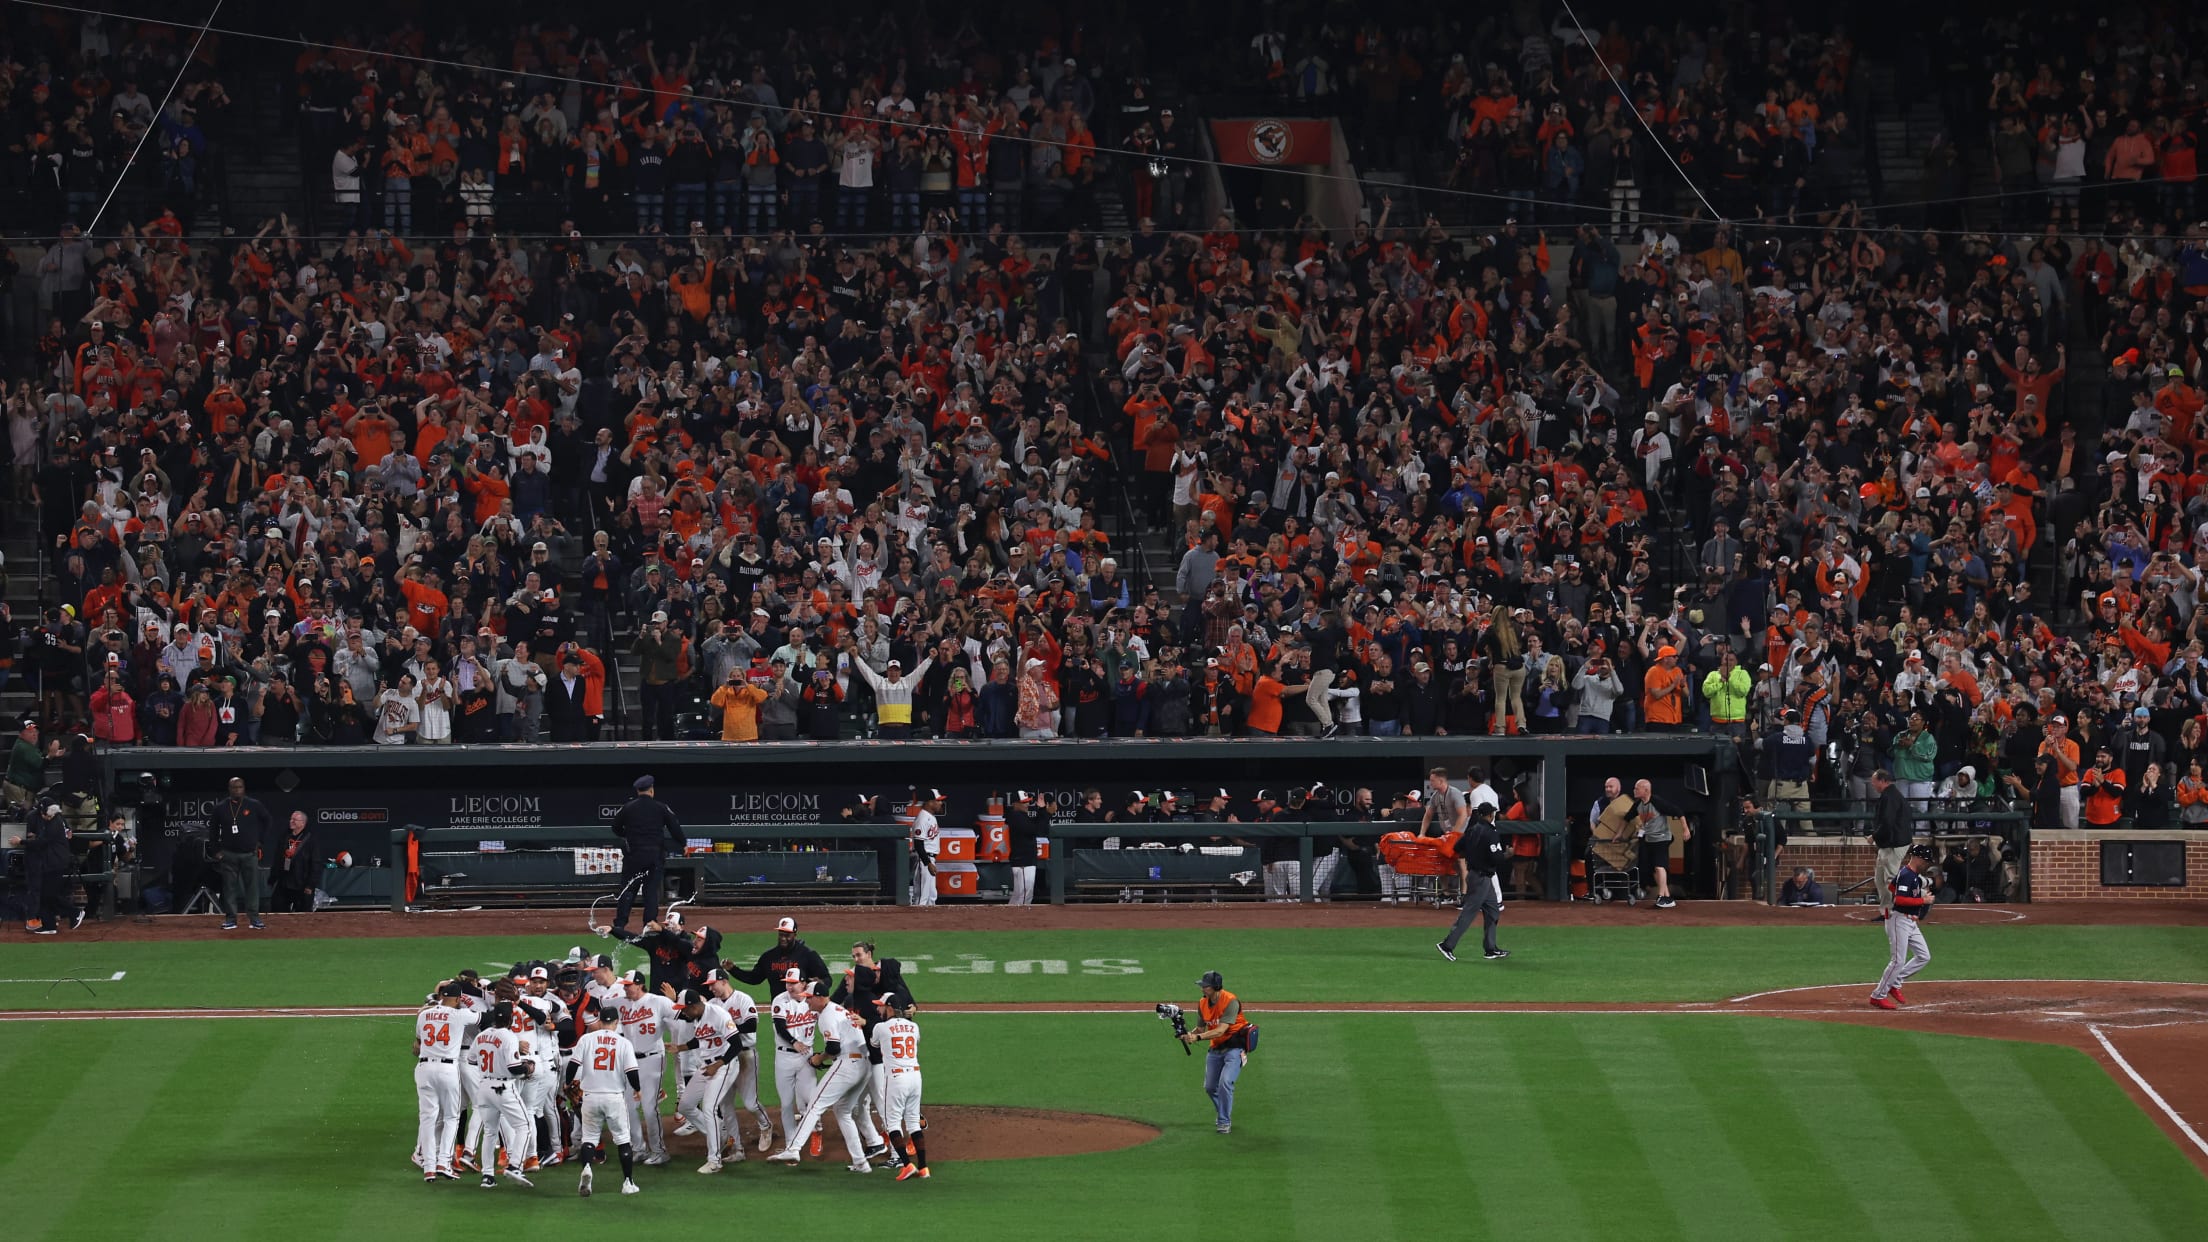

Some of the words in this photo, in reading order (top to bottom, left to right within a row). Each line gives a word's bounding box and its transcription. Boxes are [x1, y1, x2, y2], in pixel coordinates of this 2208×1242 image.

[450, 816, 471, 824] LAKE
[472, 816, 490, 824] ERIE
[491, 816, 529, 824] COLLEGE
[530, 815, 541, 823] OF
[730, 813, 750, 821] LAKE
[752, 813, 769, 821] ERIE
[770, 813, 807, 821] COLLEGE
[809, 813, 820, 821] OF
[990, 827, 1003, 842] G
[947, 840, 961, 854] G
[949, 875, 962, 889] G
[425, 1013, 449, 1021] HICKS
[639, 1023, 656, 1035] 35
[804, 1026, 814, 1038] 13
[889, 1022, 915, 1034] PÉREZ
[423, 1024, 450, 1047] 34
[597, 1035, 617, 1046] HAYS
[891, 1036, 915, 1059] 58
[479, 1049, 495, 1073] 31
[594, 1048, 616, 1071] 21
